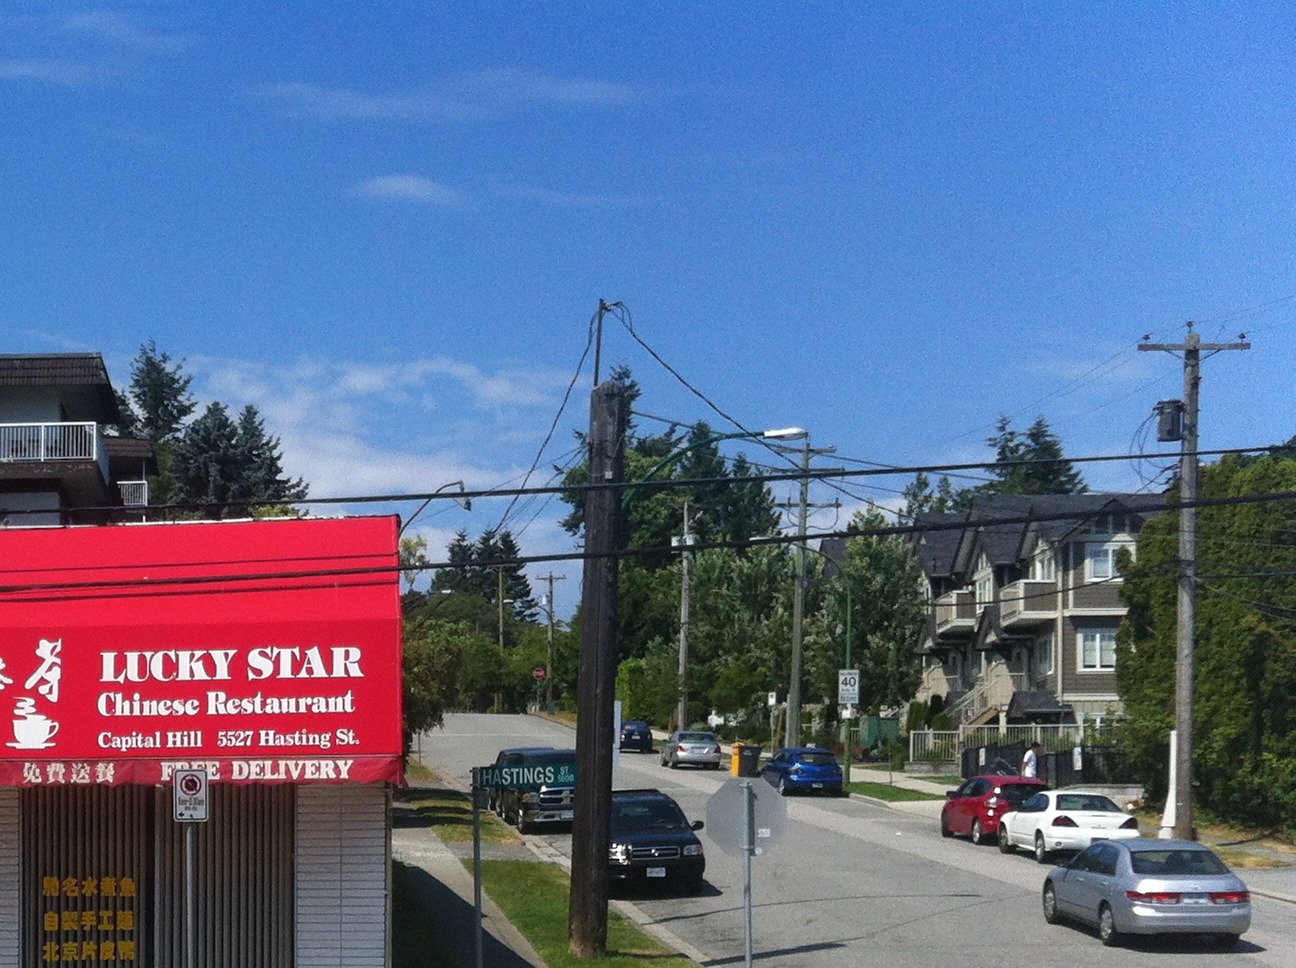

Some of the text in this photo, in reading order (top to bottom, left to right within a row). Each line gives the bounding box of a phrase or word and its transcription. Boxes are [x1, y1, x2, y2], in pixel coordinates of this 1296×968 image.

[99, 646, 365, 684] LUCKY STAR
[841, 676, 857, 687] 40
[97, 690, 356, 717] Chinese Restaurant
[97, 728, 361, 752] Capital Hill 5527 Hasting St.
[231, 760, 354, 780] DELIVERY
[482, 766, 569, 785] HASTINGS ST
